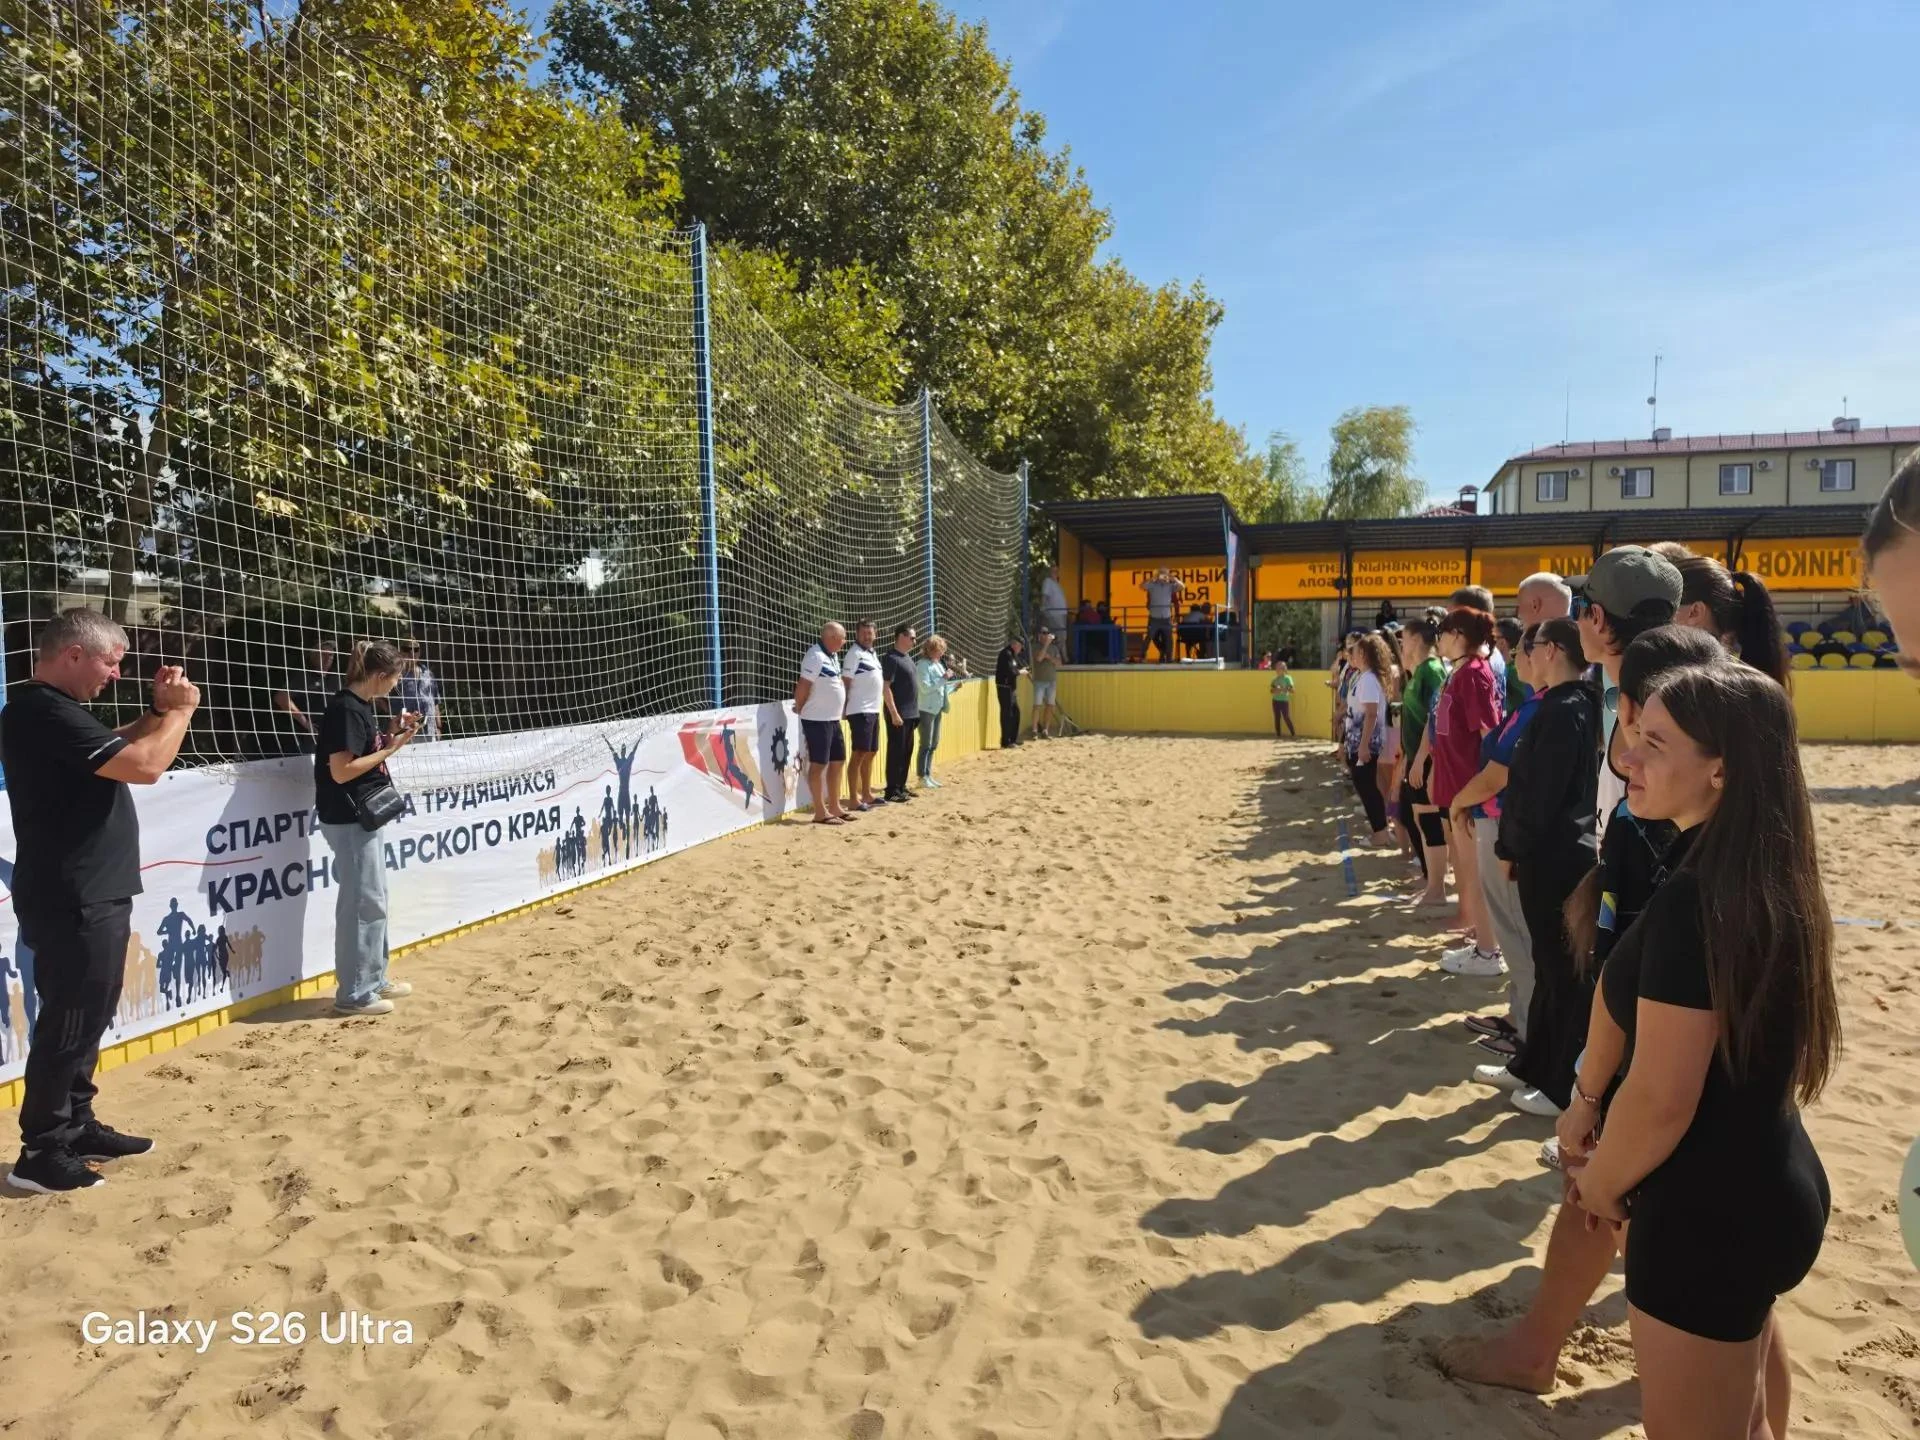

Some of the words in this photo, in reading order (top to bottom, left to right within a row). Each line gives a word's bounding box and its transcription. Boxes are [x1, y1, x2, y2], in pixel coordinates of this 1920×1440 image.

[1132, 564, 1227, 586] ГЛВНЫЙ
[422, 769, 556, 813] ТРУДЯЩИХСЯ
[208, 819, 502, 917] КРАСНАРСКОГО
[508, 805, 561, 842] КРАЯ
